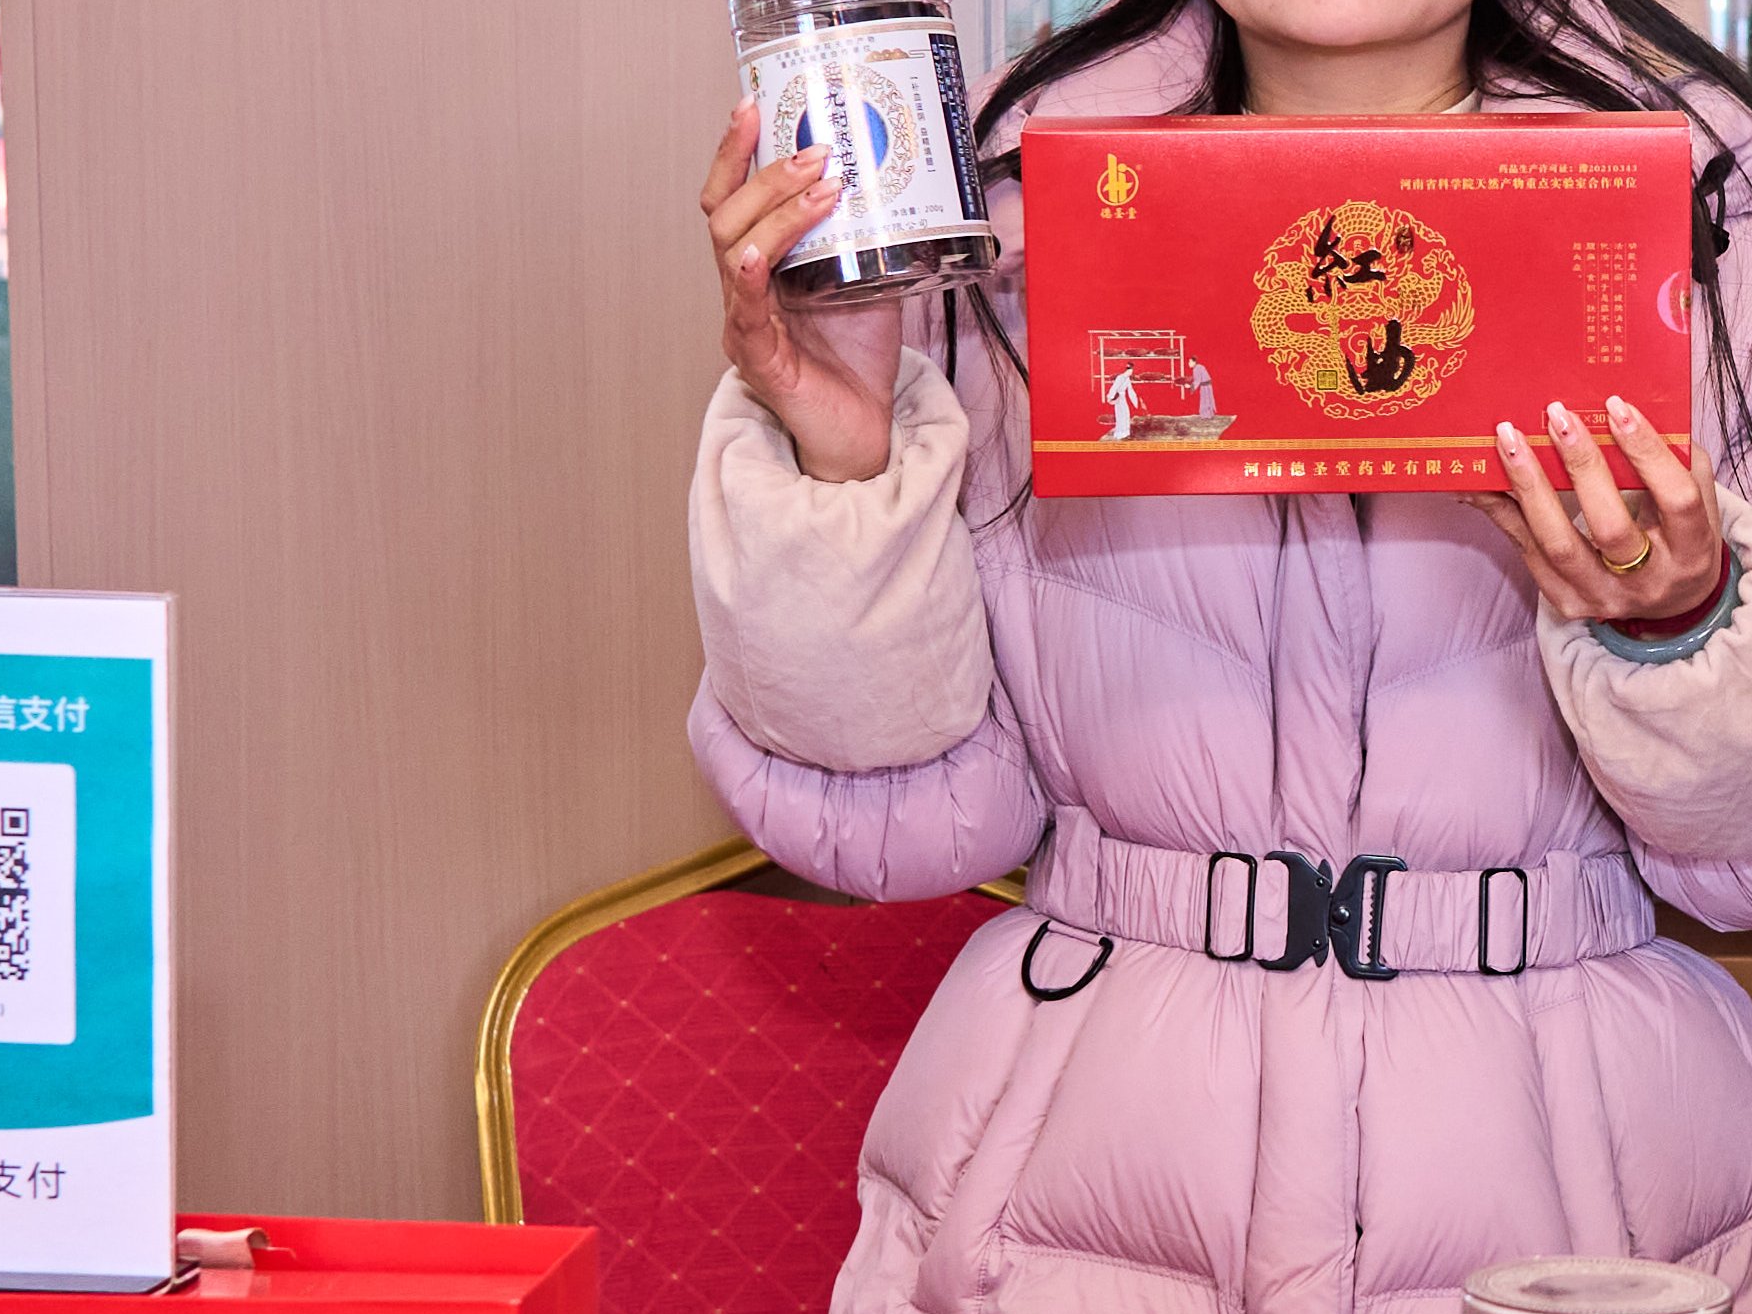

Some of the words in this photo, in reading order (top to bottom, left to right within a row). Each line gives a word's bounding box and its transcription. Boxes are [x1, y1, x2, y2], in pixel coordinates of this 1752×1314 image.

[1399, 176, 1638, 191] 河南省科学院天然产物重点实验室合作单位
[1243, 456, 1490, 479] 河南德圣堂药业有限公司
